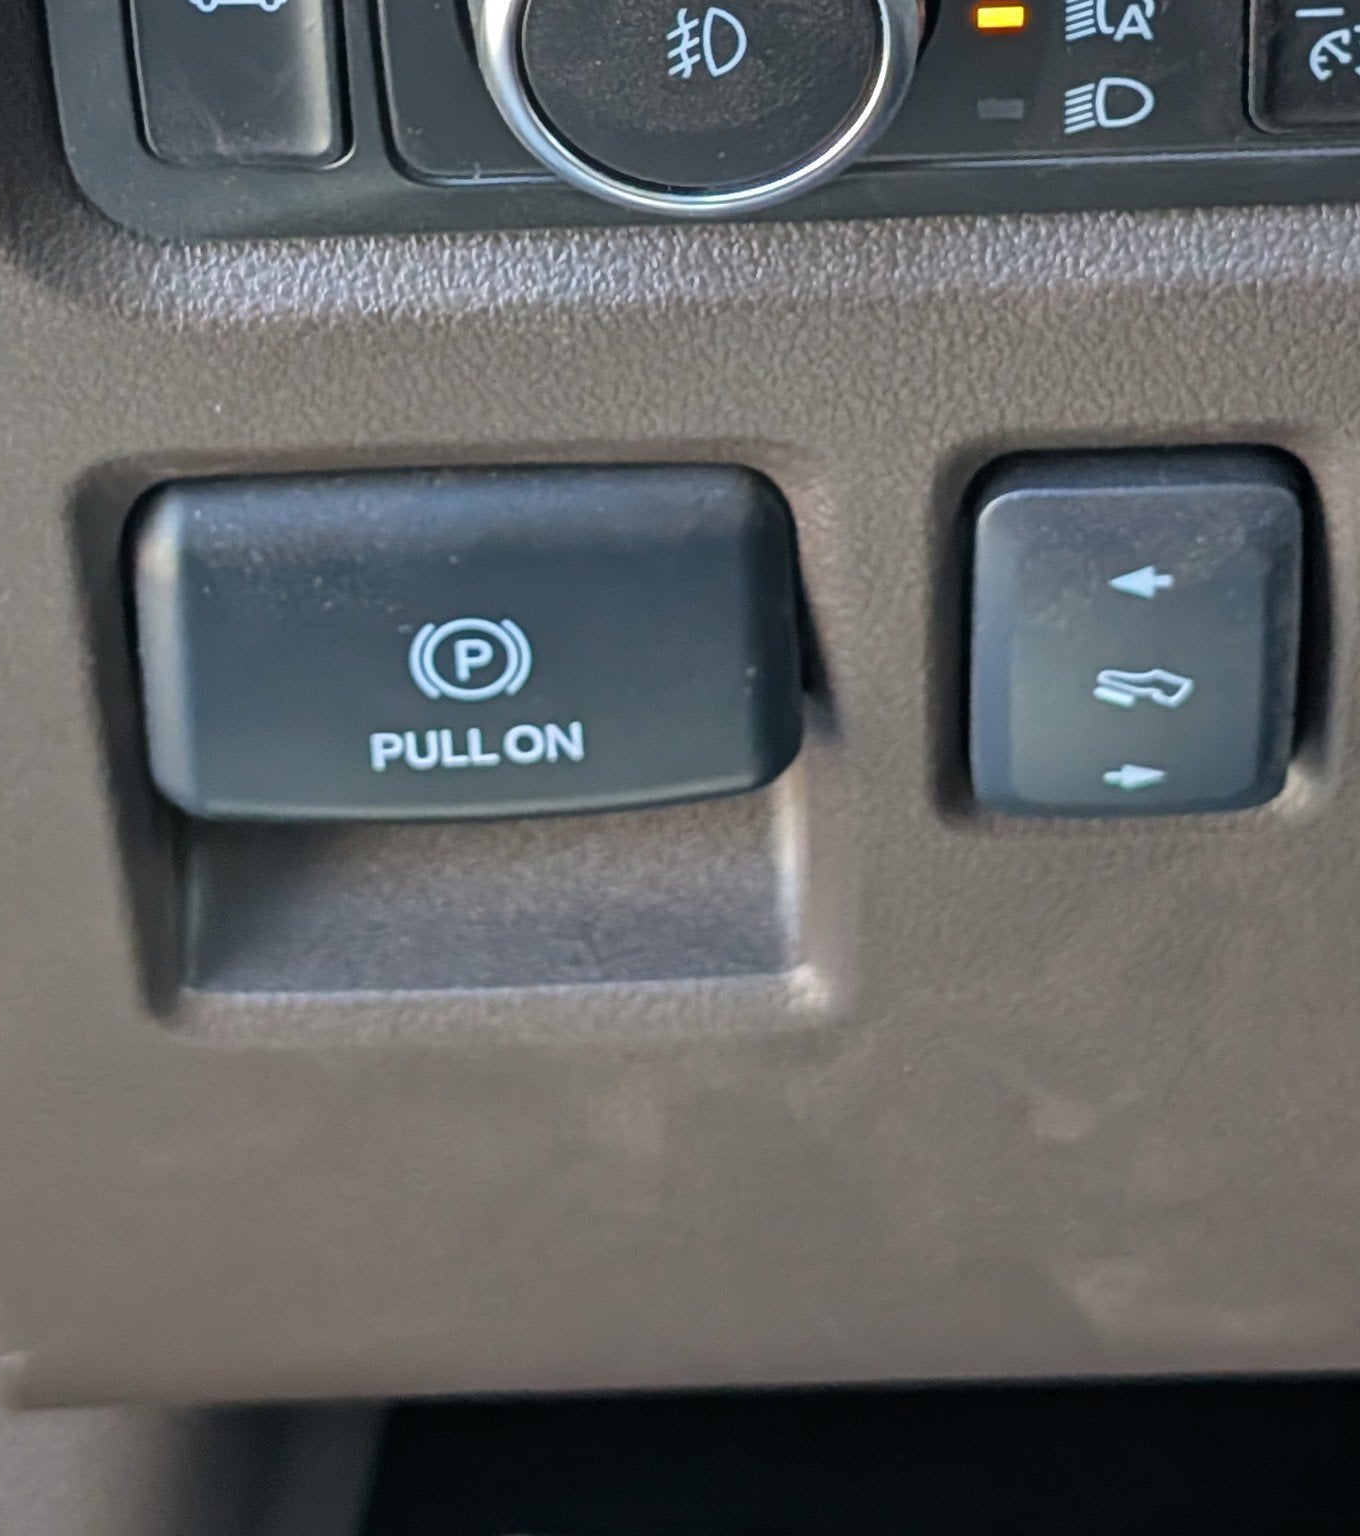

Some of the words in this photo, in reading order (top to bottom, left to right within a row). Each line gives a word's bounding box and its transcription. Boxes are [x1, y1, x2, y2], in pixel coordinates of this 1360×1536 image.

[454, 638, 494, 682] P
[369, 727, 500, 772] PULL
[503, 721, 585, 764] ON
